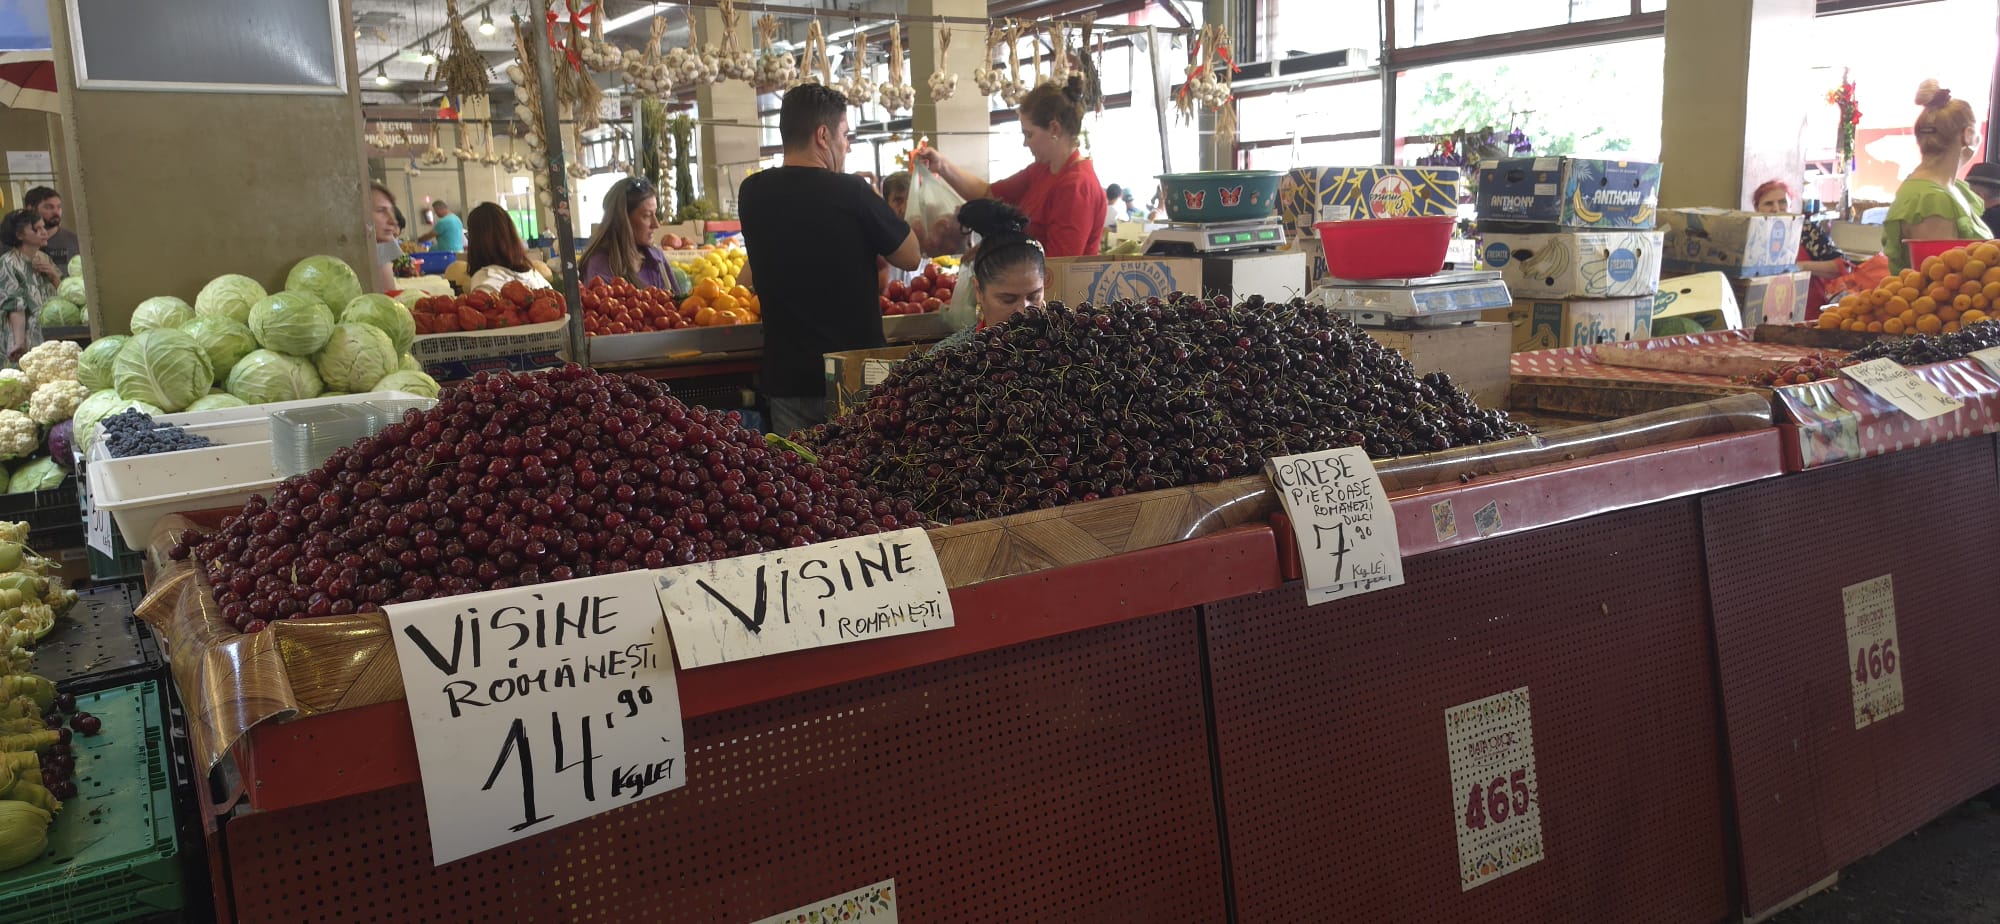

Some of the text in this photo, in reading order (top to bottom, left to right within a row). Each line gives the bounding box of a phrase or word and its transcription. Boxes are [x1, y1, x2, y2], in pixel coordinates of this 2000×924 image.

[1491, 195, 1534, 207] ANTHONY
[1594, 189, 1641, 206] ANTHONY
[1856, 638, 1895, 684] 466
[1466, 768, 1529, 830] 465
